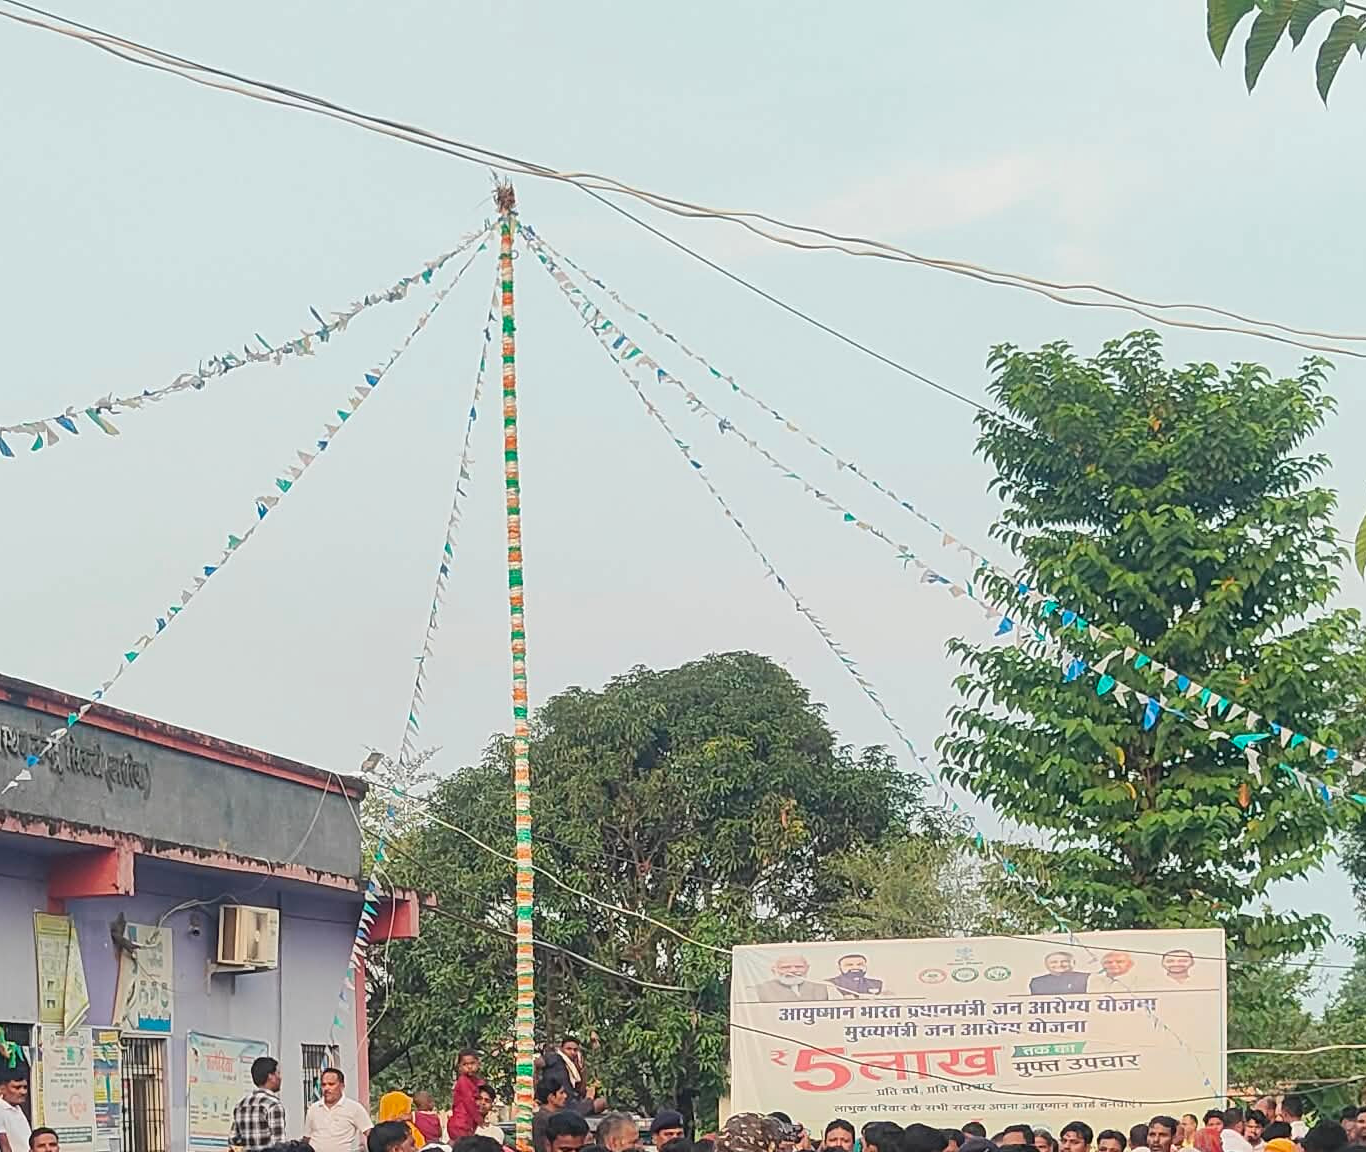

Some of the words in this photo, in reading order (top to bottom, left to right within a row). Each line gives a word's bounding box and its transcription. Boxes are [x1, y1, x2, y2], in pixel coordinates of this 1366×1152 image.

[778, 1006, 855, 1025] आयुष्मान
[859, 1005, 901, 1019] भारत
[906, 1000, 985, 1019] प्रधानमंत्री
[991, 1001, 1024, 1016] जन
[1028, 996, 1091, 1015] आरोग्य
[1096, 995, 1159, 1013] योजना
[844, 1022, 917, 1043] मुख्यमंत्री
[924, 1024, 956, 1038] जन
[960, 1019, 1023, 1036] आरोग्य
[1027, 1018, 1088, 1034] योजना
[1022, 1043, 1050, 1056] तक
[851, 1046, 1003, 1081] लाख
[1012, 1059, 1061, 1078] मुफ्त
[1066, 1054, 1141, 1071] उपचार
[875, 1086, 902, 1097] प्रति
[926, 1084, 952, 1095] प्रति
[869, 1103, 906, 1113] परिवार
[909, 1103, 922, 1113] के
[924, 1103, 949, 1112] सभी
[988, 1103, 1018, 1111] अपना
[1022, 1102, 1069, 1112] आयुष्मान
